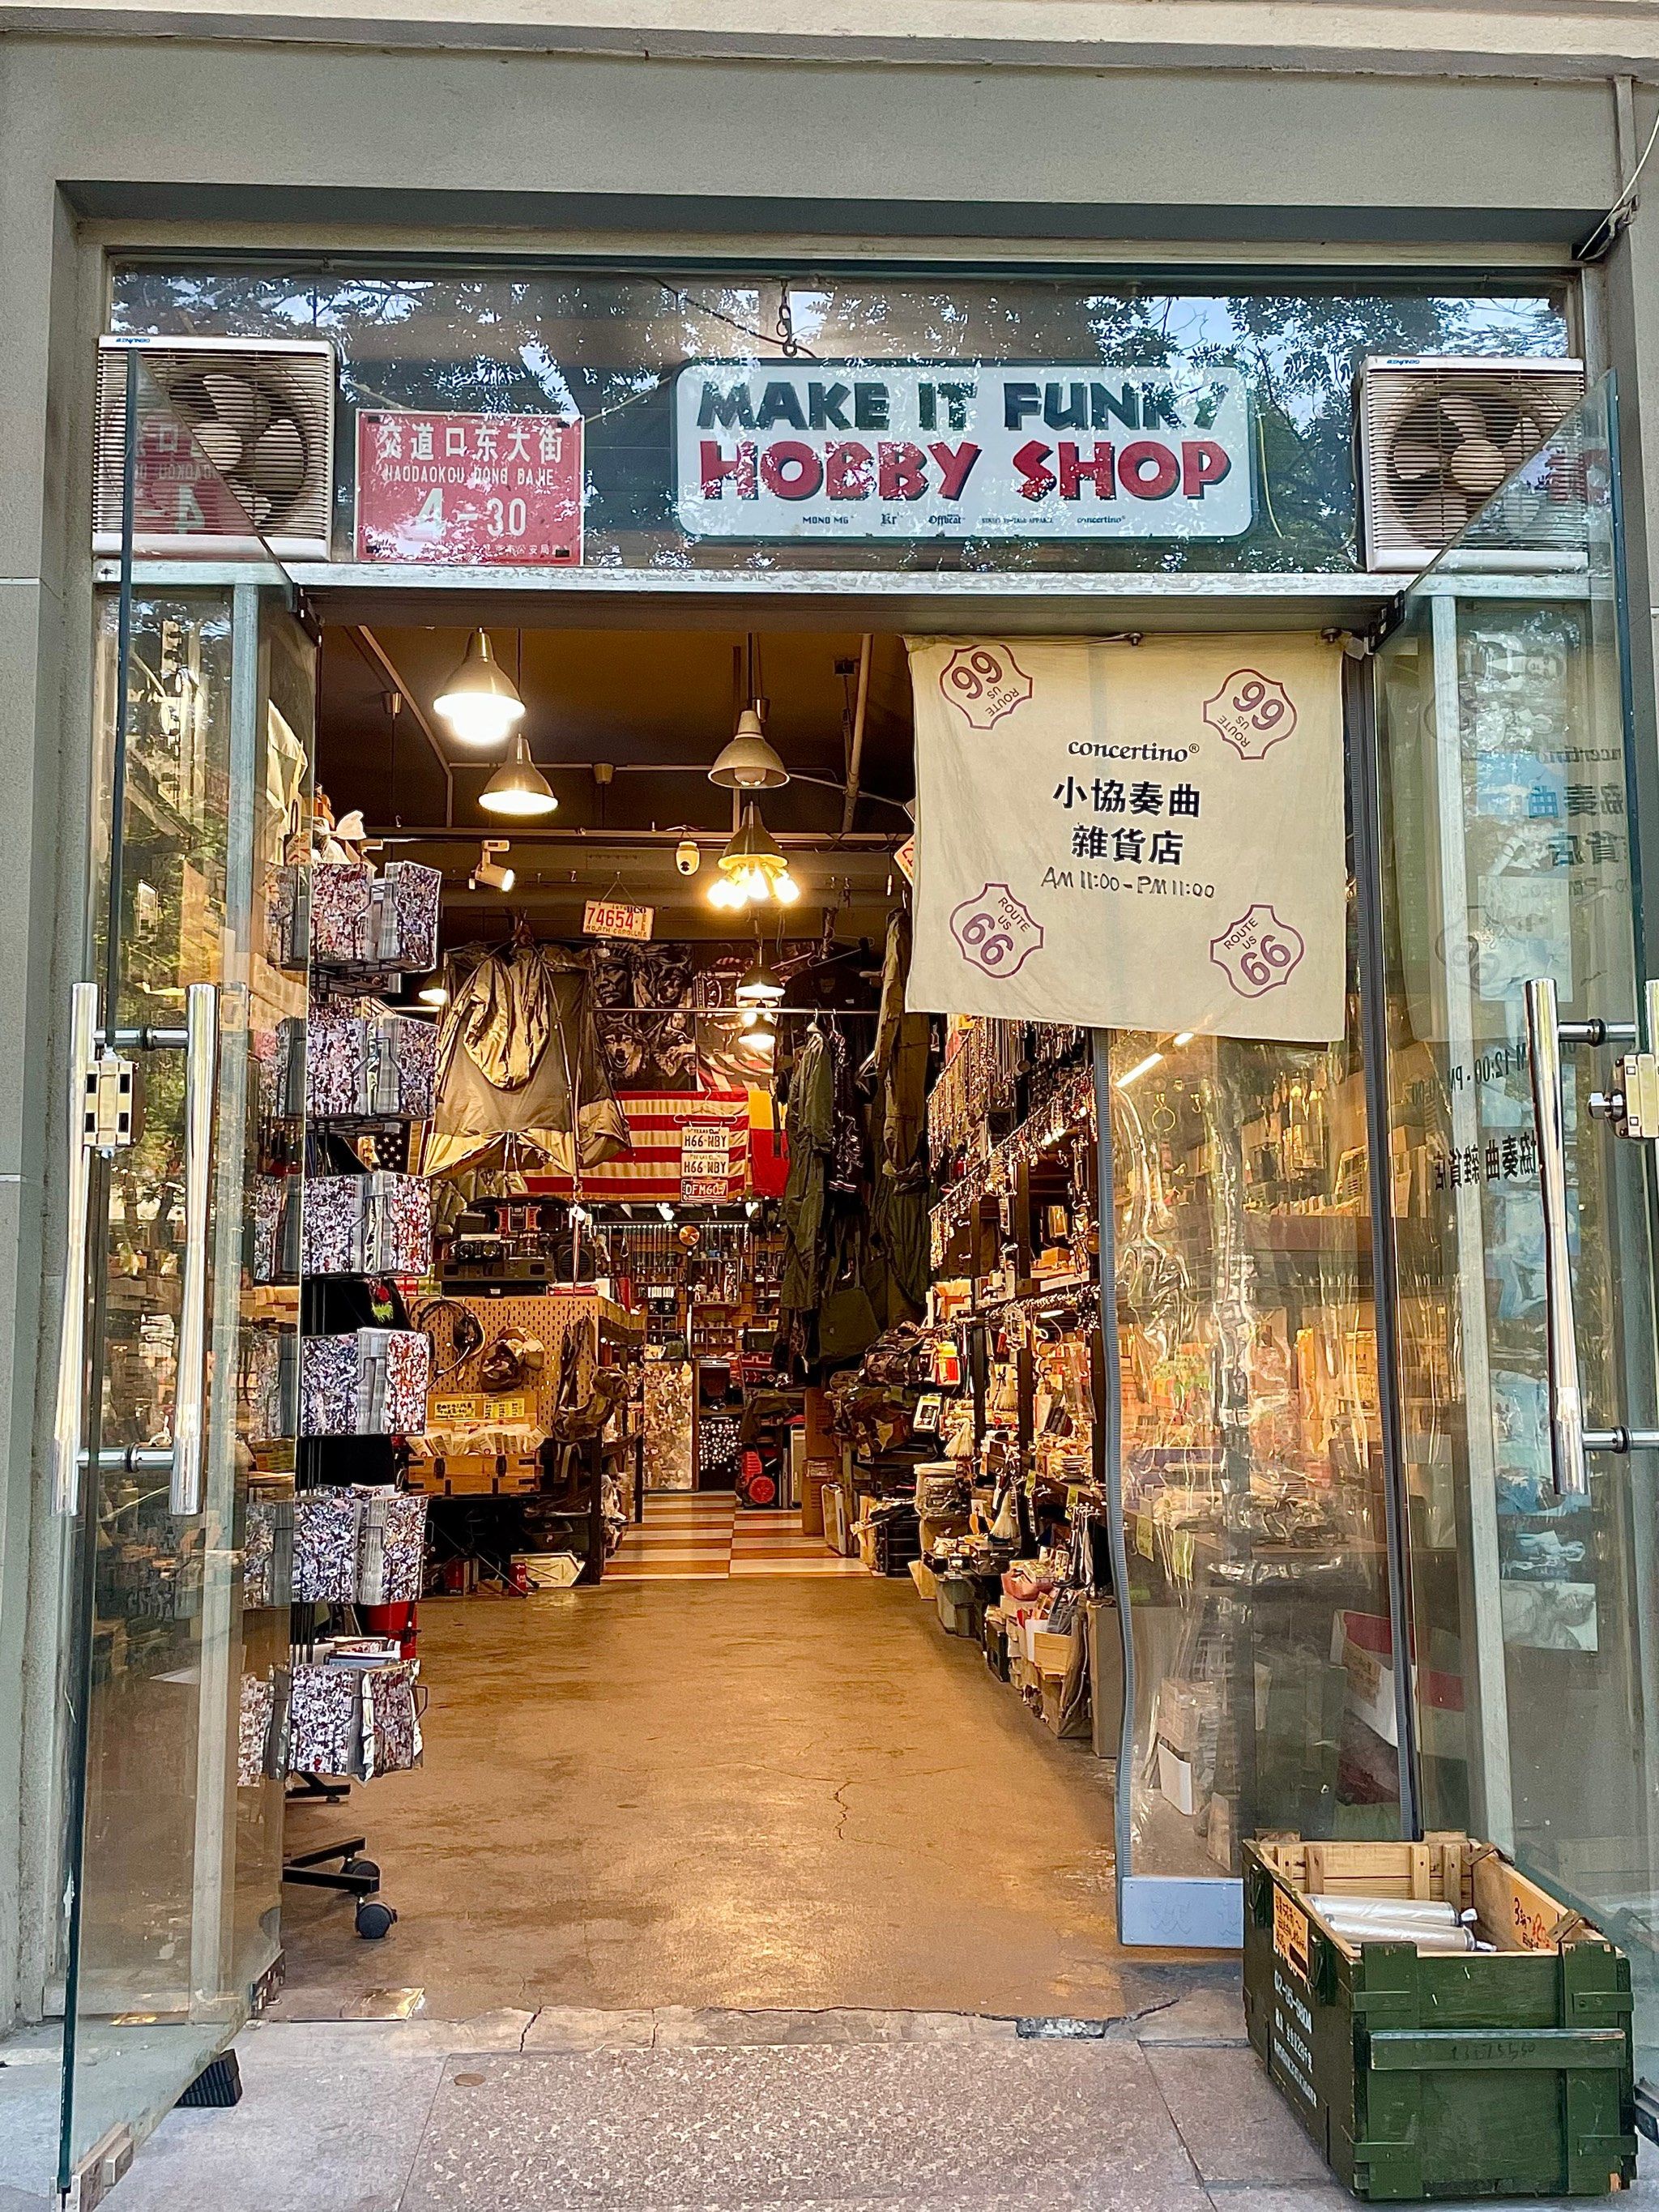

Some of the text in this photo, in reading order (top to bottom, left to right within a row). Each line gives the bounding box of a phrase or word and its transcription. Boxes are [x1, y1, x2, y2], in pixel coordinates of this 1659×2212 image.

[697, 382, 890, 431] MAKE
[918, 382, 977, 430] IT
[377, 421, 562, 464] 交道口东大街
[475, 468, 508, 485] DONG
[700, 440, 1232, 502] HOBBY SHOP
[803, 516, 831, 524] MONO
[985, 687, 1019, 717] ROUTE
[1218, 715, 1250, 748] ROUTE
[1052, 775, 1201, 818] 小協奏曲
[1071, 822, 1184, 866] 雜貨店
[1041, 866, 1073, 889] AM
[587, 907, 633, 930] 74654
[997, 896, 1030, 932] ROUTE
[998, 915, 1012, 929] US
[962, 913, 1013, 964] 66
[1223, 917, 1259, 950] ROUTE
[1242, 936, 1257, 950] US
[1239, 934, 1291, 985] 66
